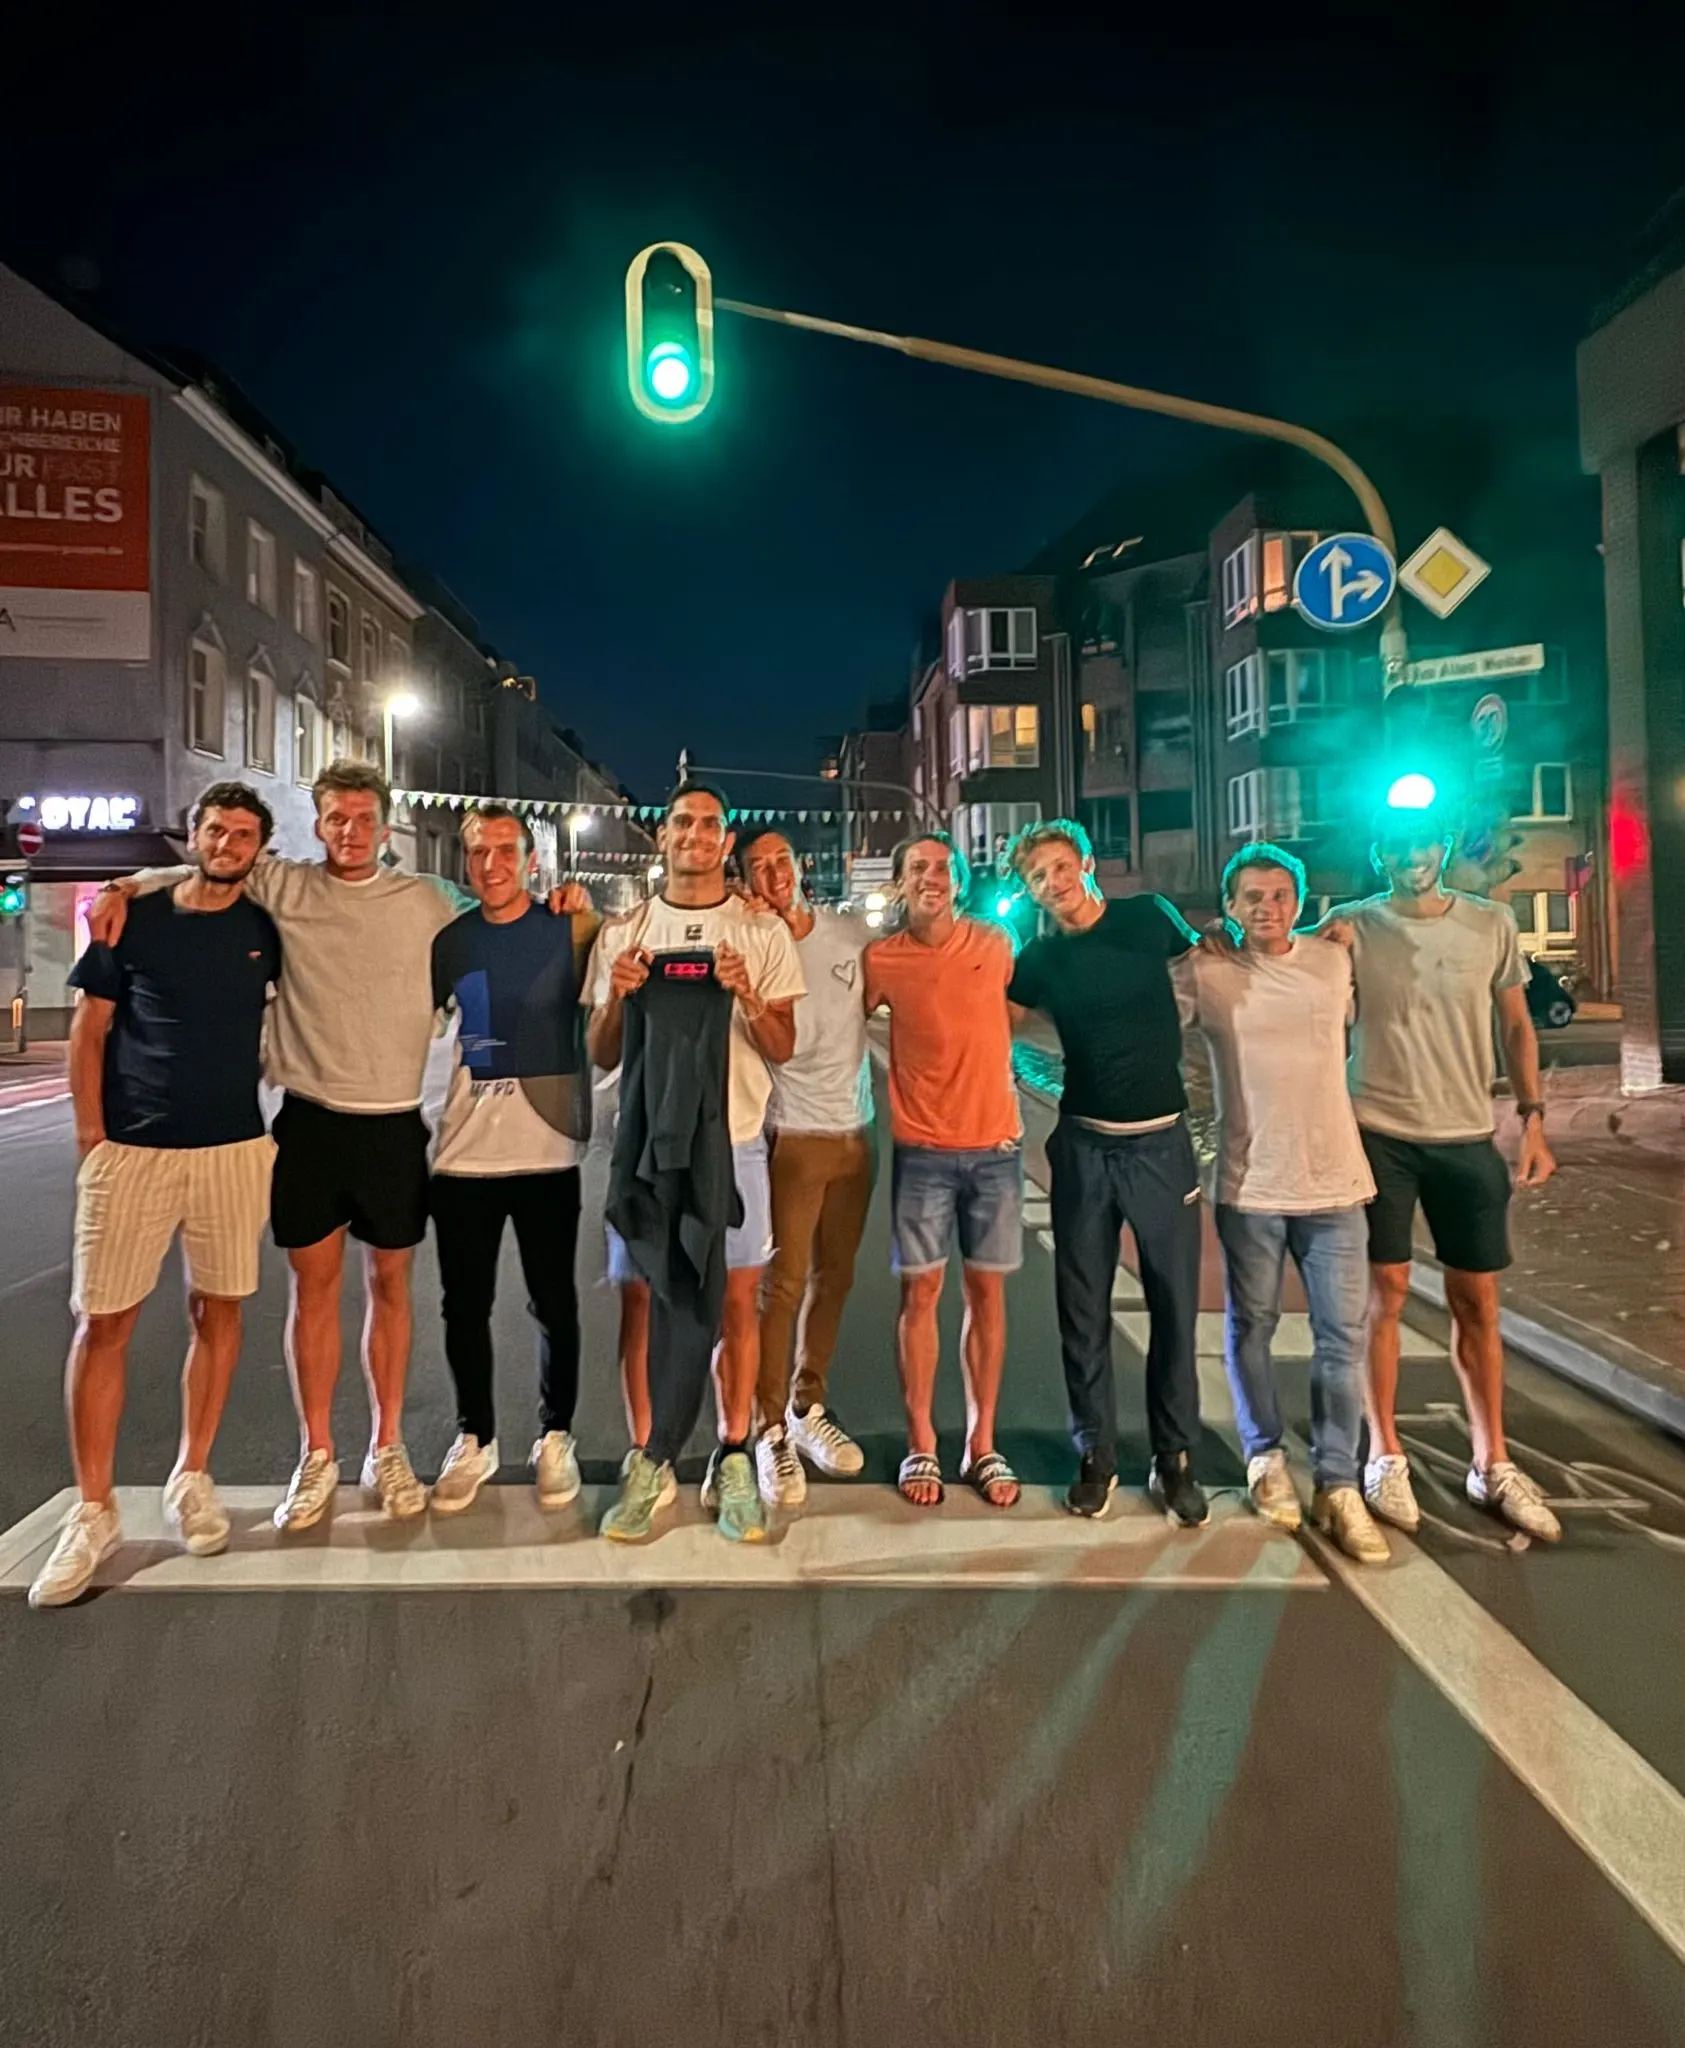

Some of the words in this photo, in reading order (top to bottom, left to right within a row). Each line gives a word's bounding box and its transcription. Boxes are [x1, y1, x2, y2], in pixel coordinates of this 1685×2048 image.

[0, 405, 21, 427] R
[31, 407, 121, 432] HABEN
[0, 483, 123, 523] LLES
